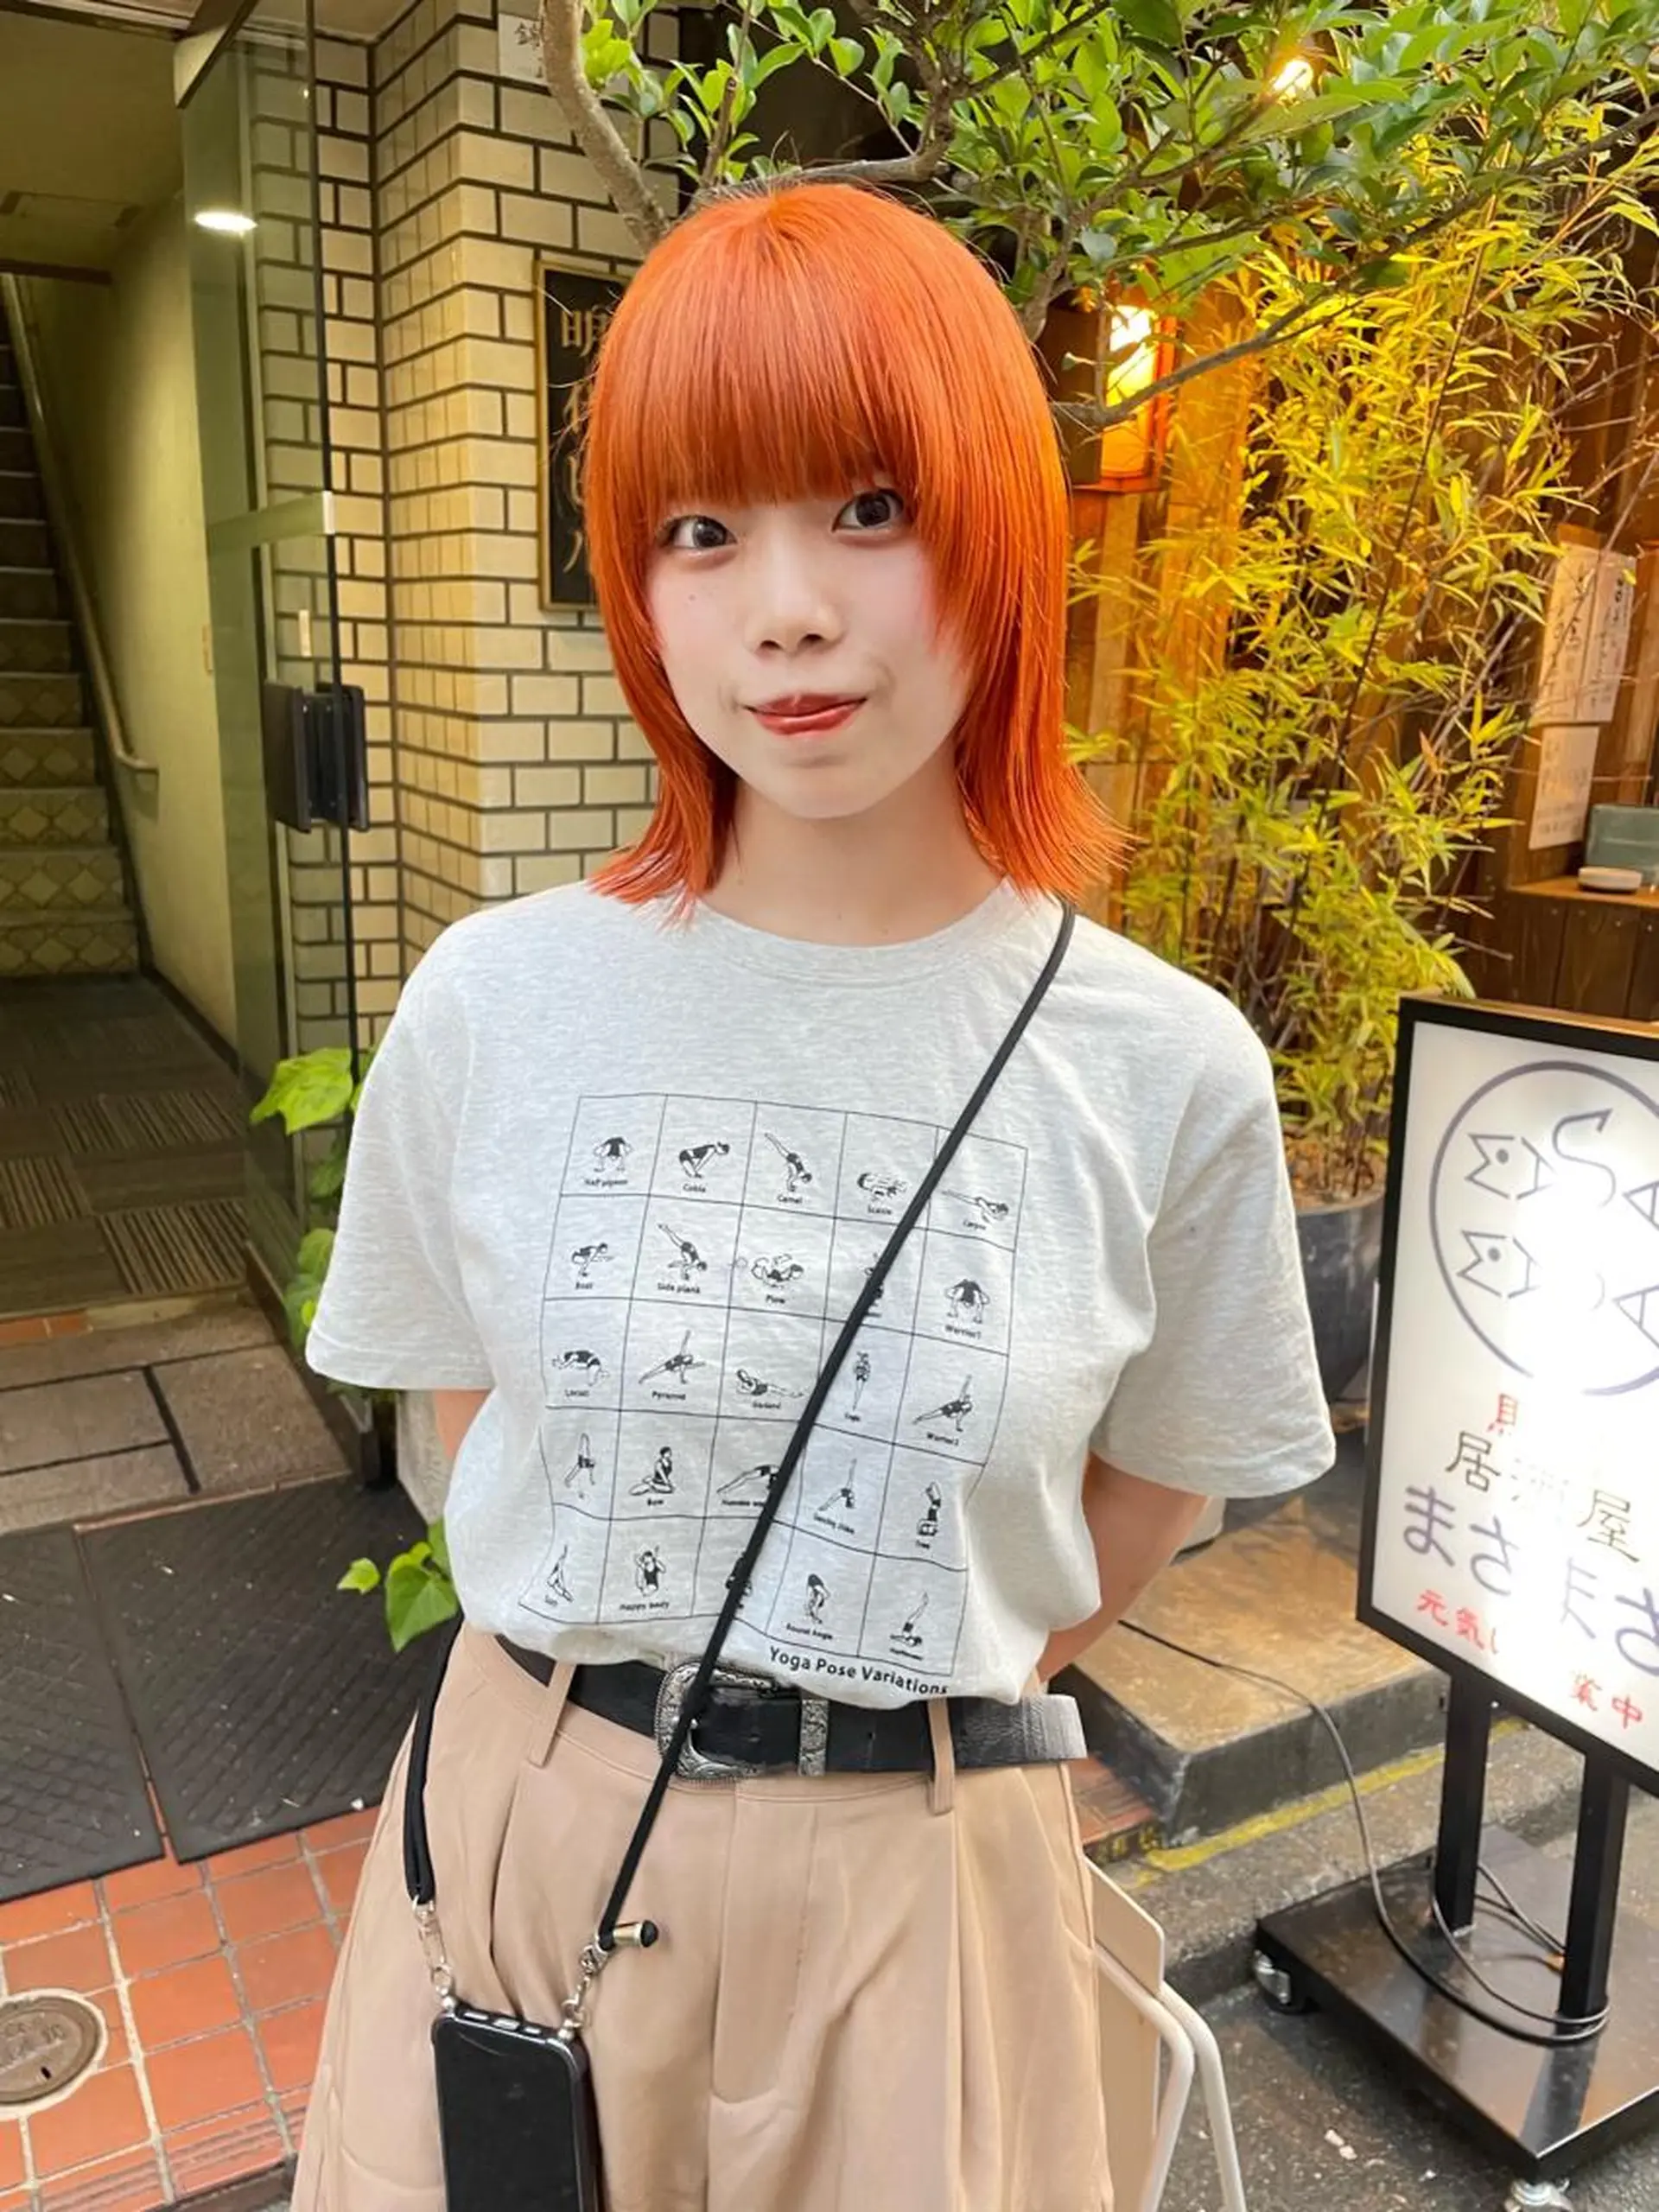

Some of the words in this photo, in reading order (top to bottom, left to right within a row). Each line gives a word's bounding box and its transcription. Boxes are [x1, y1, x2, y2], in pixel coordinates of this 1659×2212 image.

[1446, 1430, 1640, 1563] 居屋
[770, 1646, 810, 1671] Yoga
[816, 1657, 857, 1679] Pose
[862, 1666, 949, 1695] Variations
